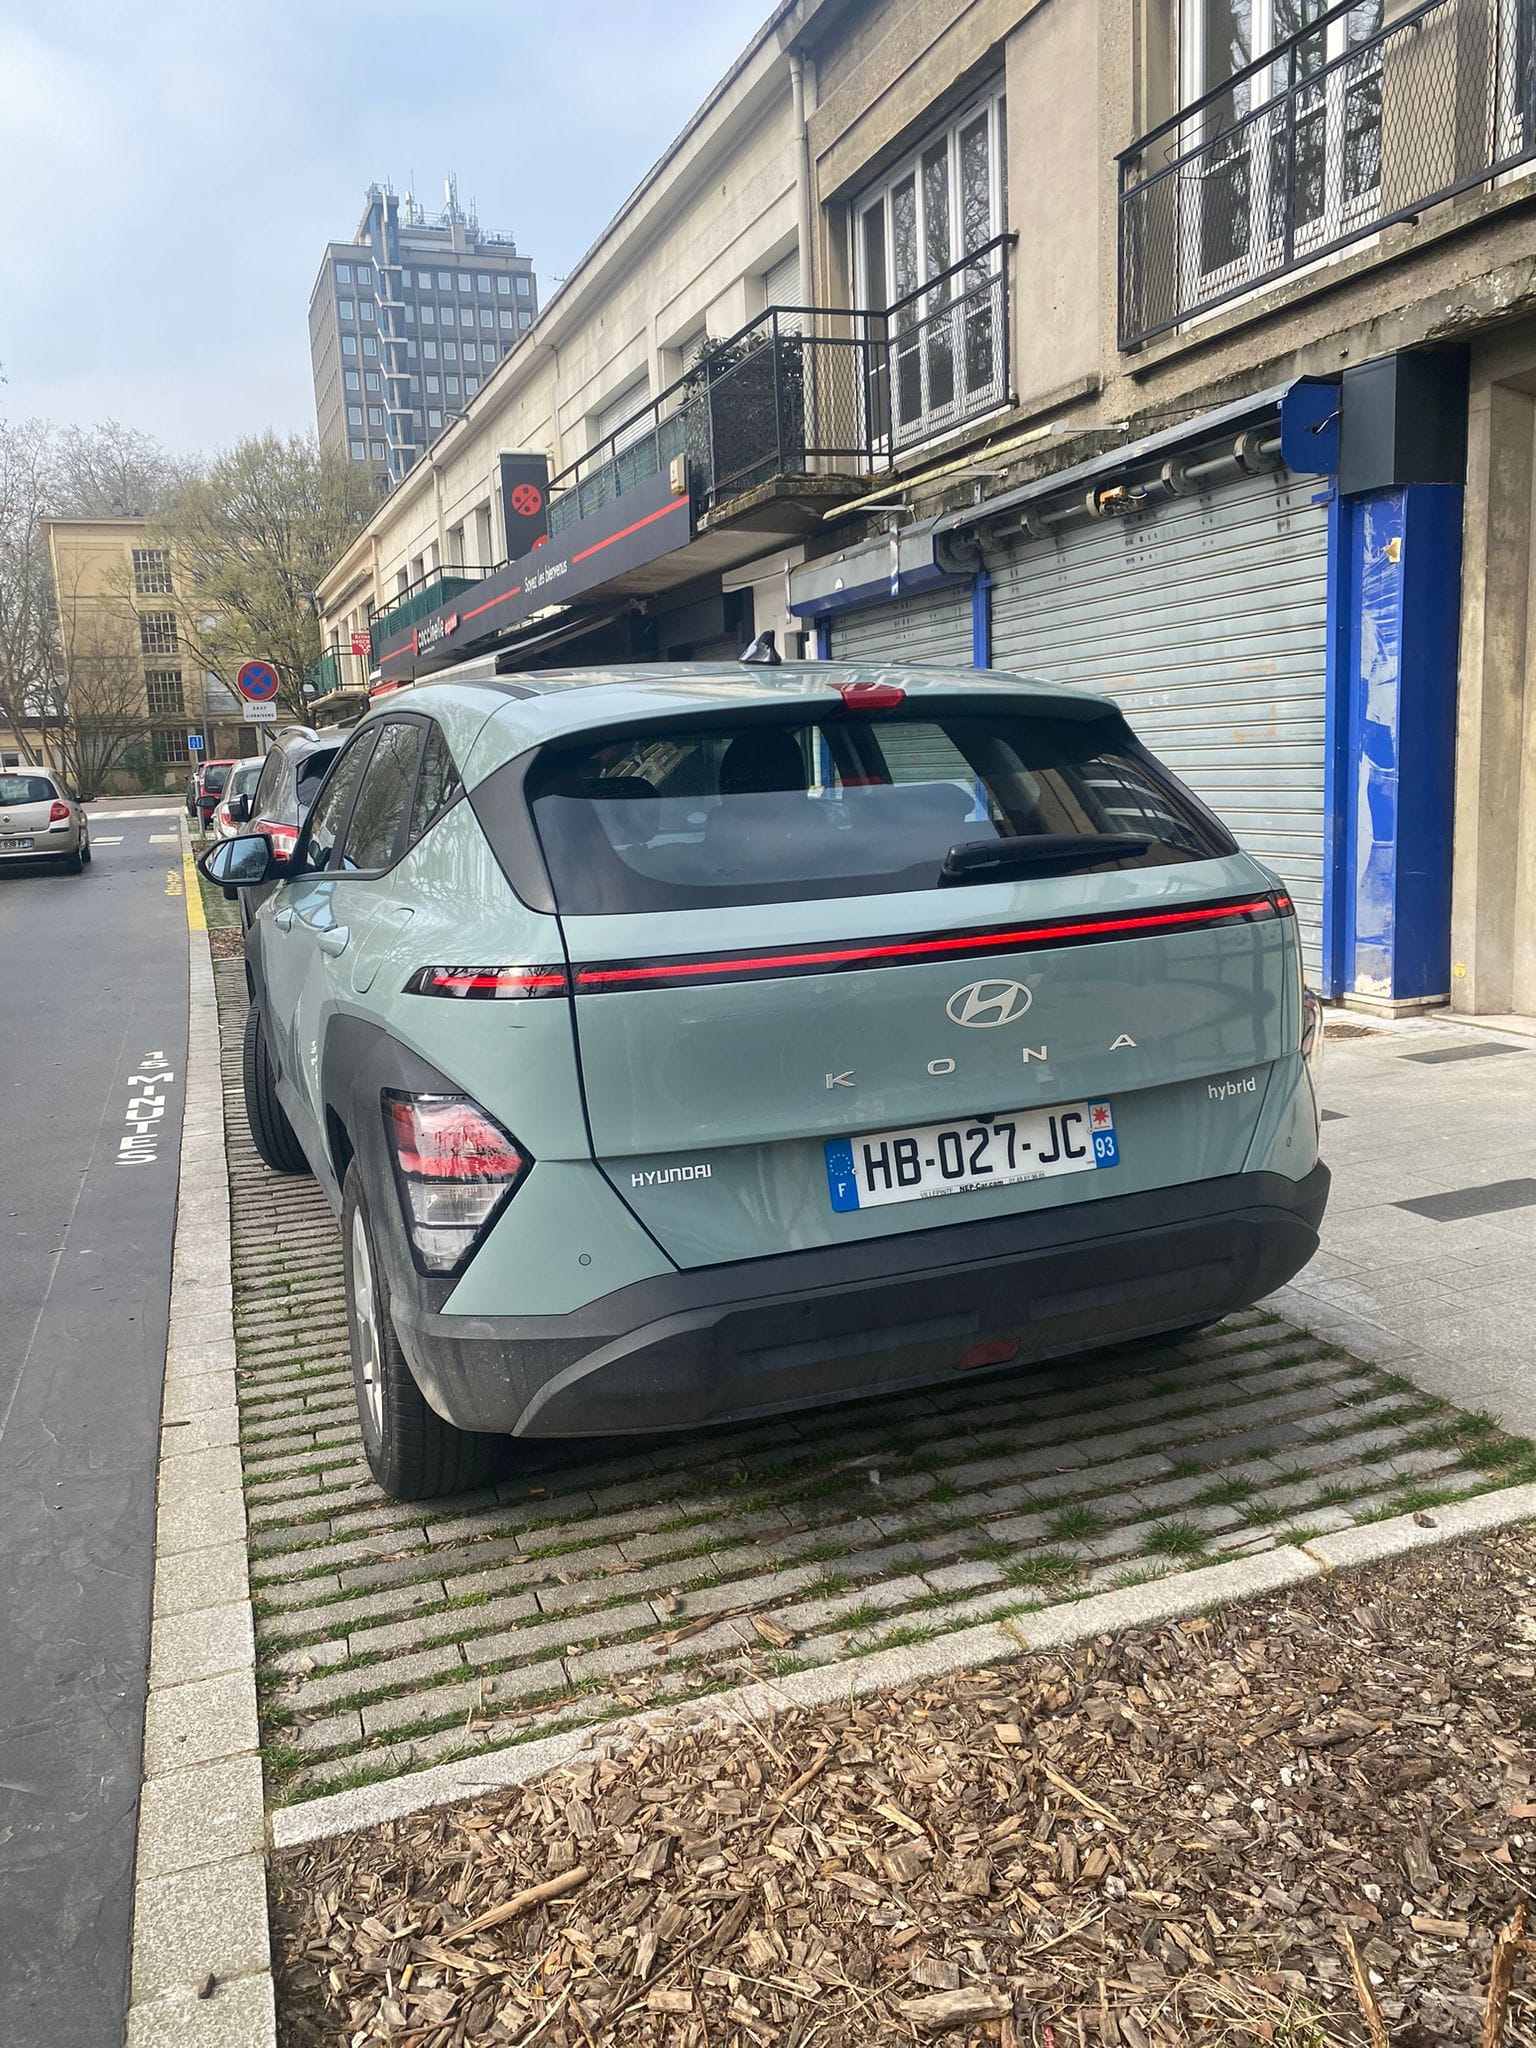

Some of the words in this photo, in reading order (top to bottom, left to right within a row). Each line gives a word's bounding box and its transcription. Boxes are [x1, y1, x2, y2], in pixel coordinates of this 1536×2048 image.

[524, 576, 537, 595] Soyez
[537, 568, 545, 587] les
[545, 560, 568, 583] bienvenus
[418, 616, 444, 649] coccinelle
[137, 1050, 170, 1070] 15
[825, 1033, 1138, 1089] KONA
[1207, 1077, 1257, 1102] hybrid
[114, 1072, 175, 1165] MINUTES
[837, 1182, 847, 1199] F
[863, 1112, 1087, 1193] HB-027-JC
[1095, 1136, 1115, 1158] 93
[631, 1164, 712, 1188] HYUNDAI
